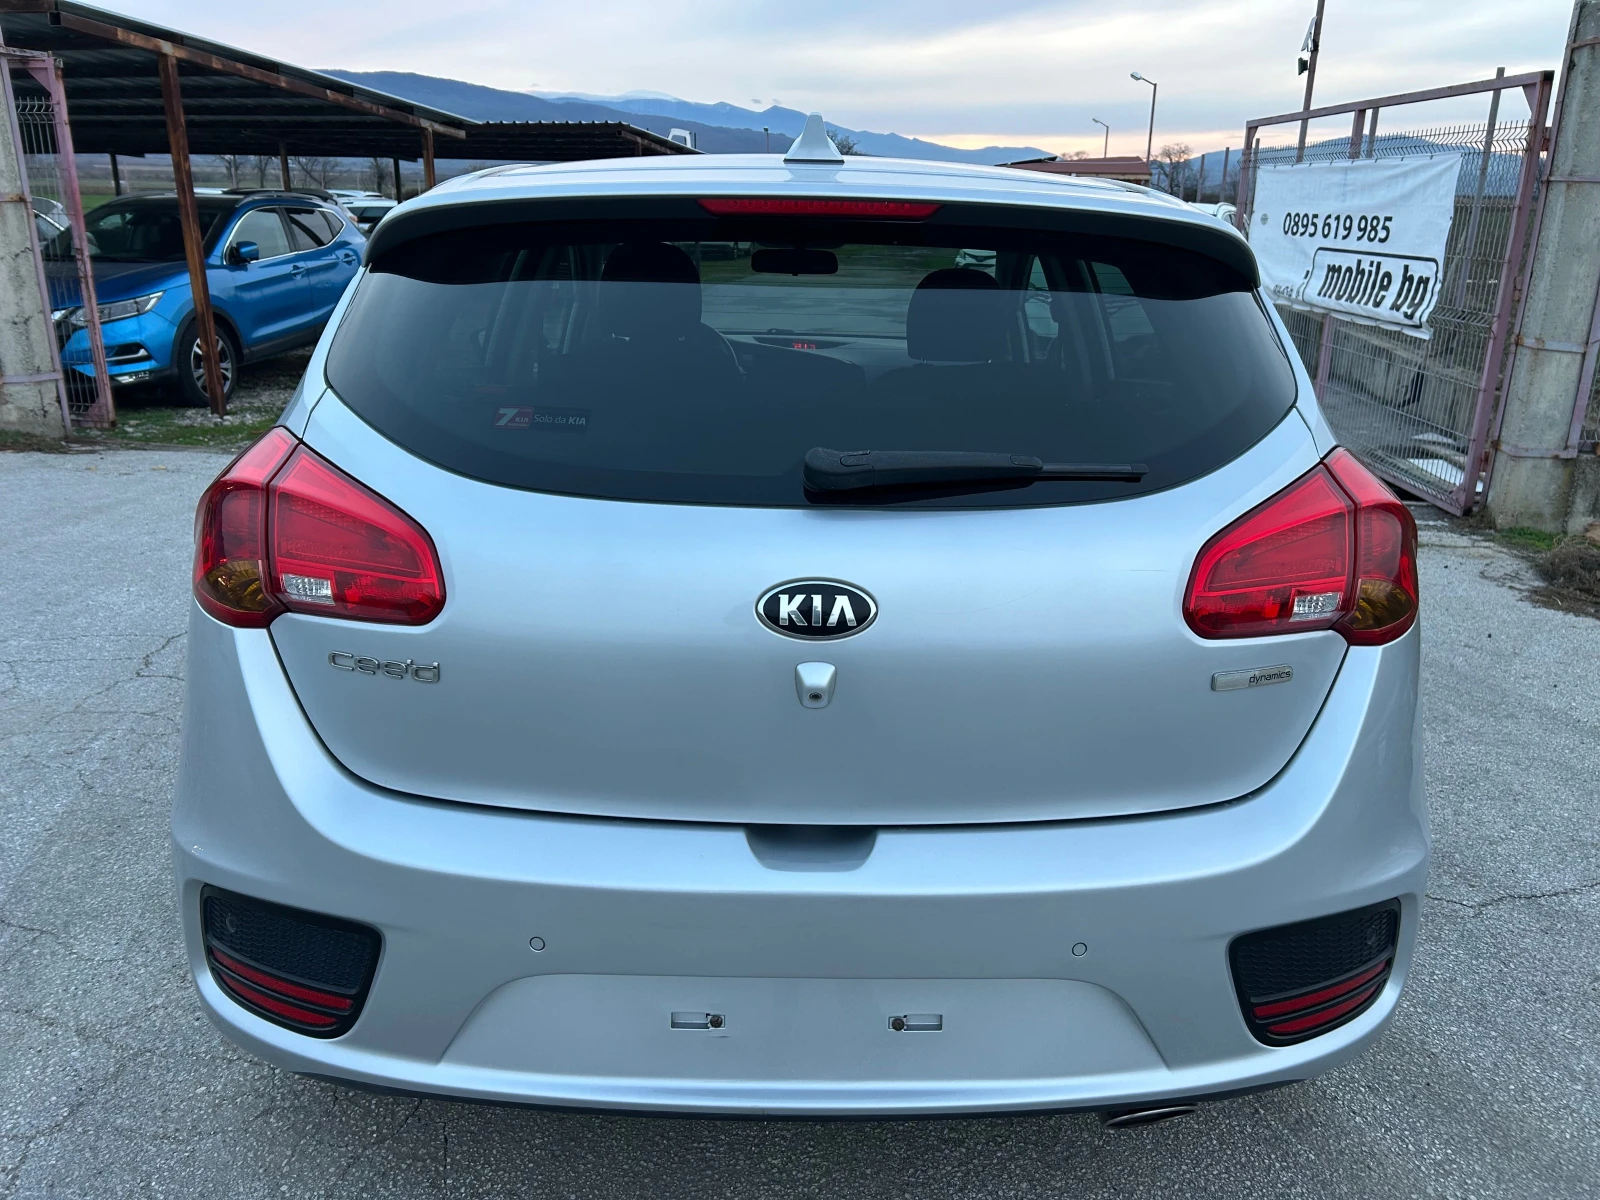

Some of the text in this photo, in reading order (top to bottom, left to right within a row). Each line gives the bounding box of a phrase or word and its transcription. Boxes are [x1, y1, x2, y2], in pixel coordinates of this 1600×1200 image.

[1283, 212, 1393, 243] 0895 619 985
[534, 414, 586, 426] Solo da KIA
[778, 594, 857, 627] KIA
[1249, 669, 1292, 685] dynamics
